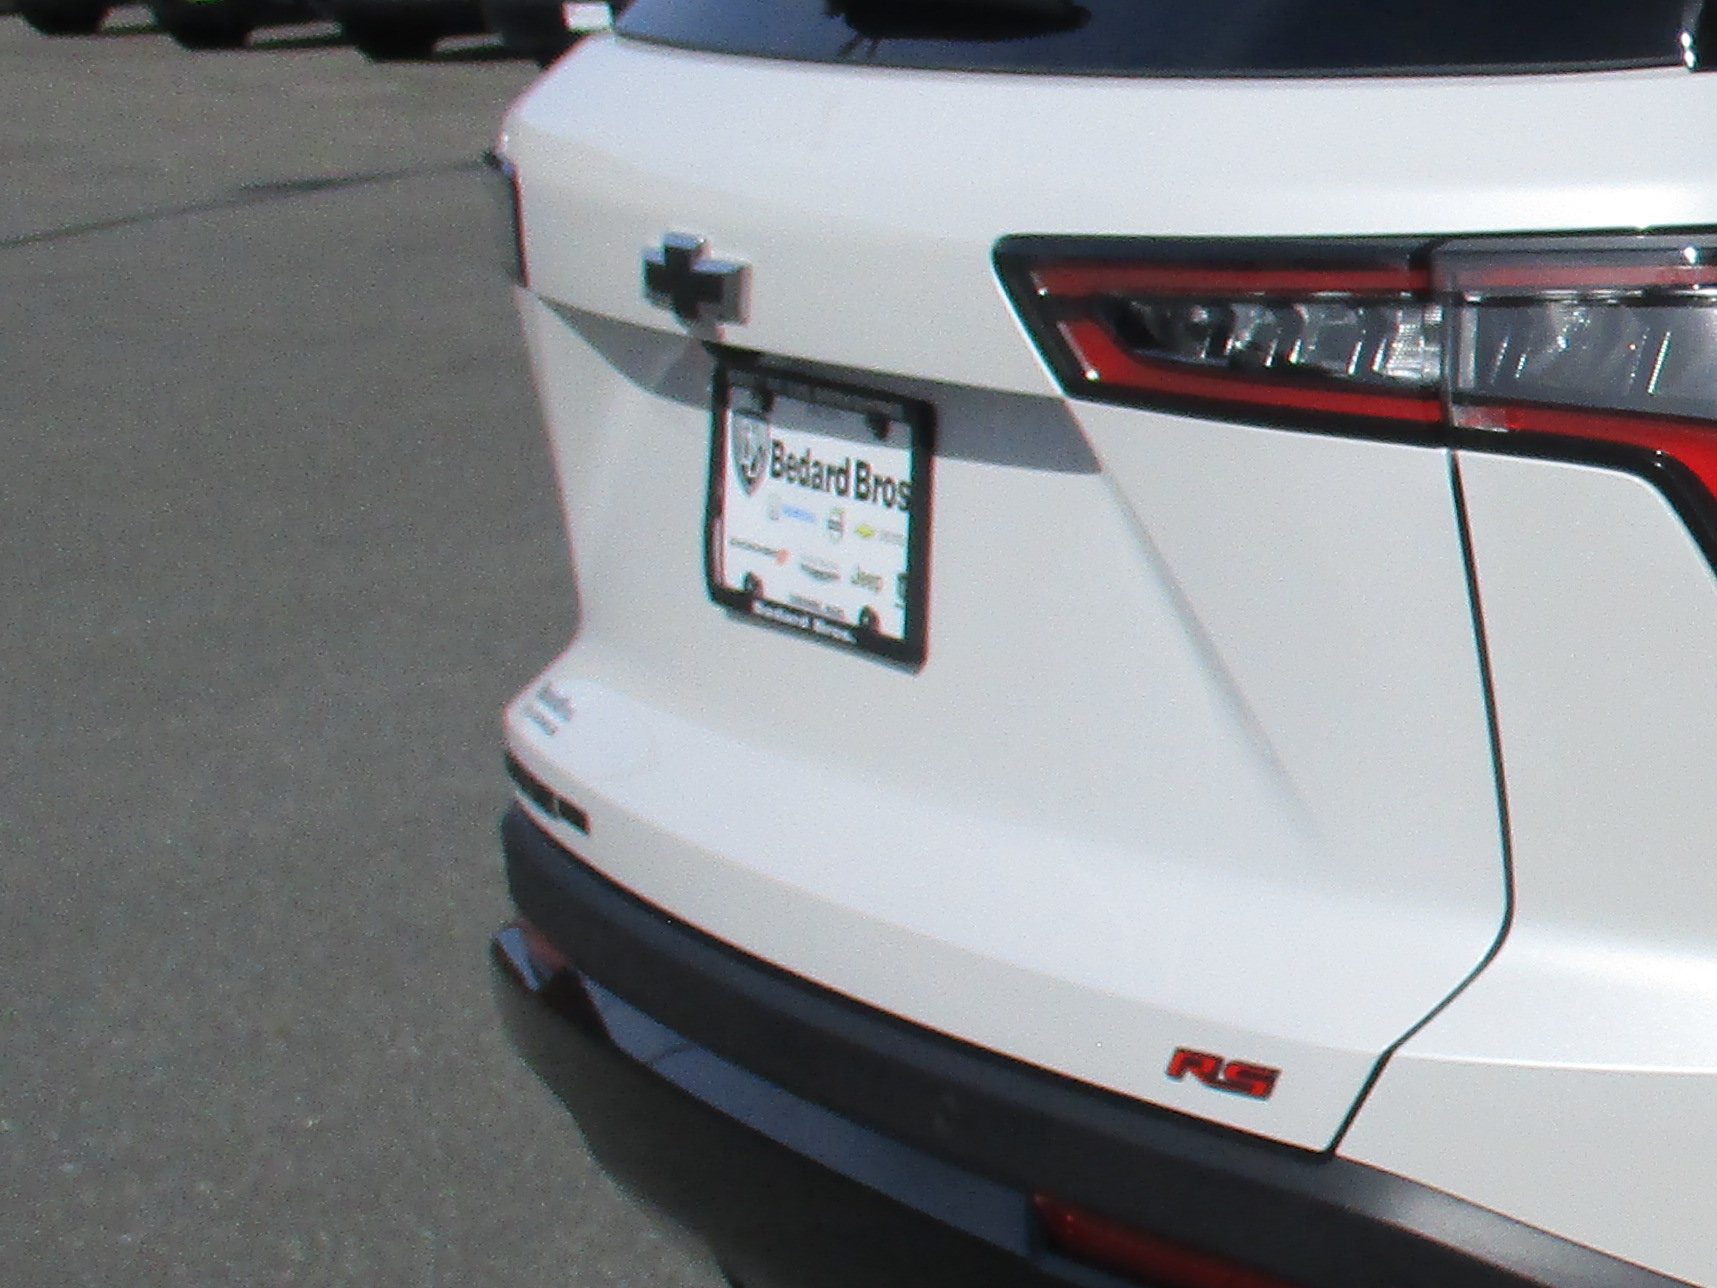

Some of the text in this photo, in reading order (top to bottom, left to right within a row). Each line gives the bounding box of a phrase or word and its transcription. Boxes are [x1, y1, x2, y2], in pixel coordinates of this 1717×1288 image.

[771, 438, 852, 497] Bedard
[855, 458, 912, 511] Bros
[1165, 1045, 1282, 1101] RS
